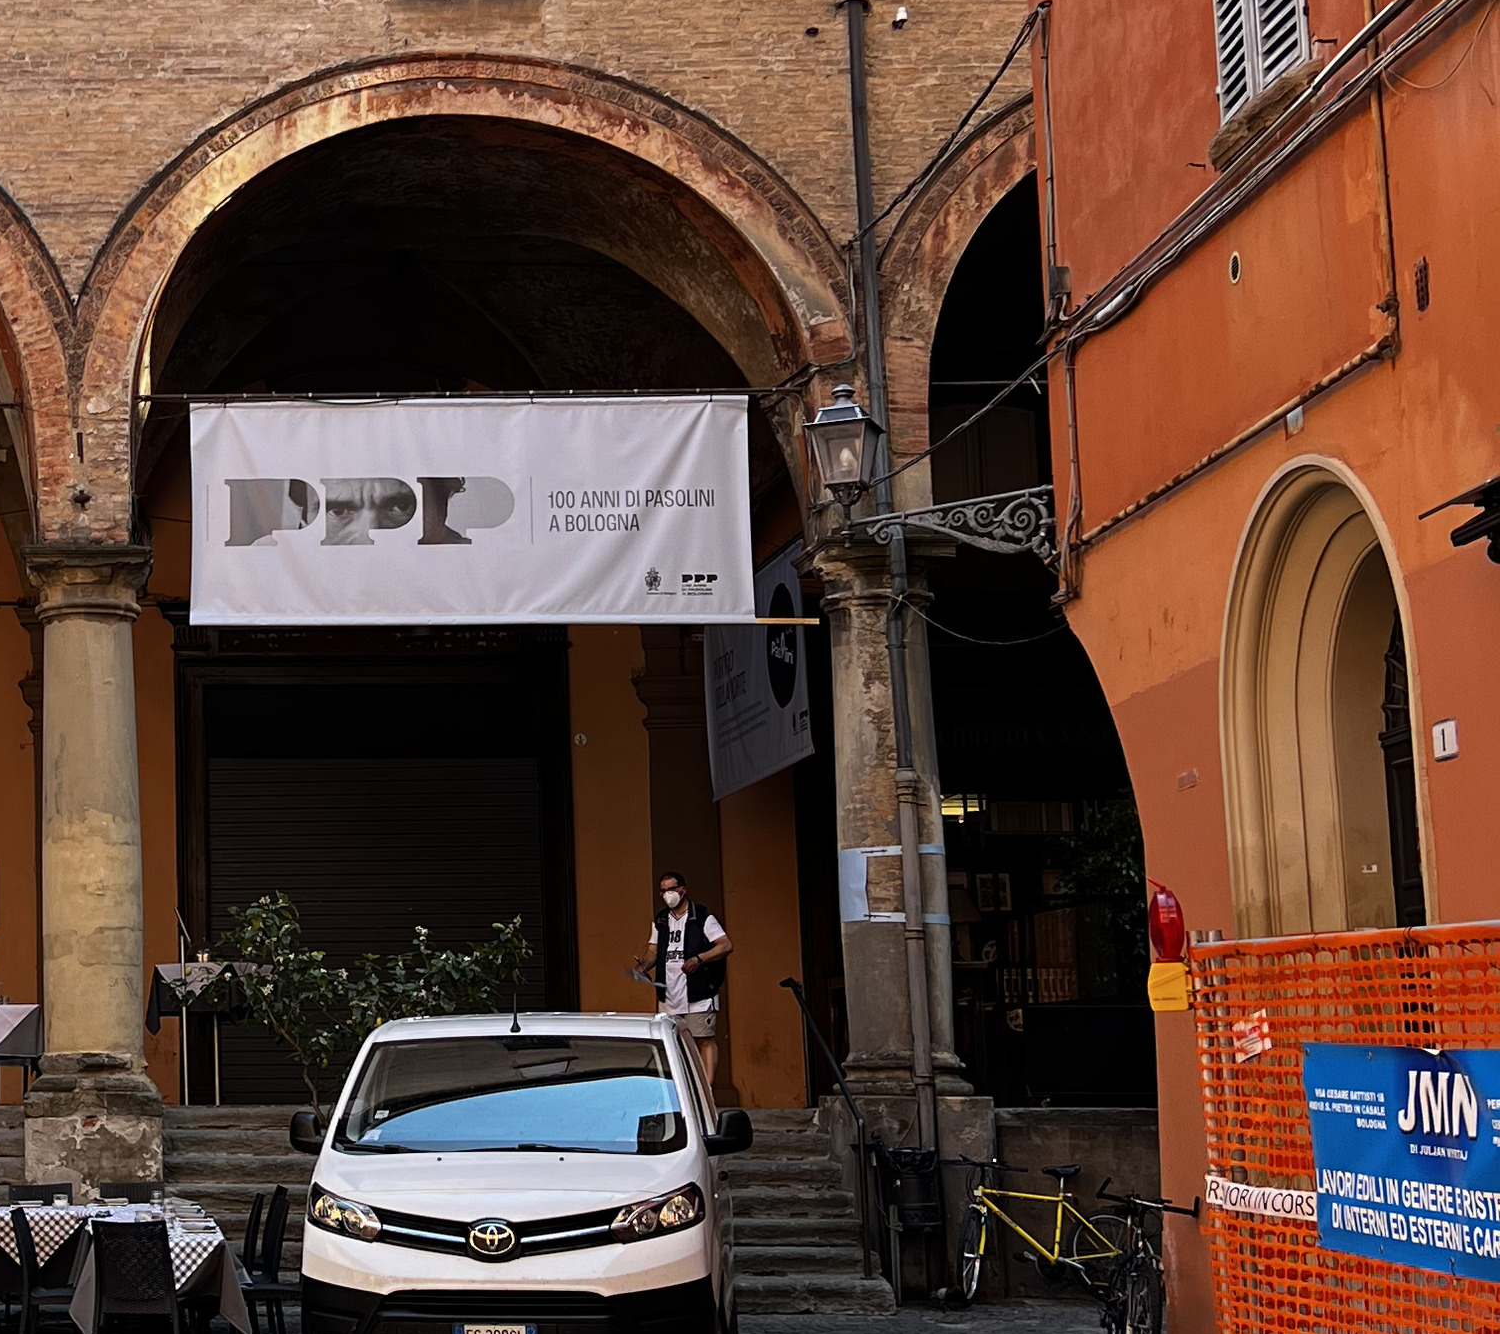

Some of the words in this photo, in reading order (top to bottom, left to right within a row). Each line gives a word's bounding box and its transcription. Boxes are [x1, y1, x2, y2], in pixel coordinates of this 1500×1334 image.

[548, 490, 576, 509] 100
[580, 490, 620, 509] ANNI
[625, 489, 641, 508] DI
[645, 489, 715, 508] PASOLINI
[224, 476, 515, 546] PPP
[549, 514, 560, 532] A
[565, 513, 640, 532] BOLOGNA
[681, 574, 718, 583] PPP
[1398, 1070, 1479, 1139] JMN
[1356, 1117, 1388, 1130] BOLOGNA
[1410, 1143, 1418, 1154] DI
[1316, 1167, 1356, 1199] LAVORI
[1356, 1173, 1385, 1204] EDILI
[1385, 1177, 1400, 1206] IN
[1401, 1179, 1455, 1215] GENERE
[1454, 1187, 1463, 1216] E
[1331, 1202, 1344, 1230] DI
[1343, 1204, 1390, 1238] INTERNI
[1390, 1212, 1408, 1242] ED
[1410, 1215, 1463, 1252] ESTERNI
[1462, 1224, 1474, 1254] E
